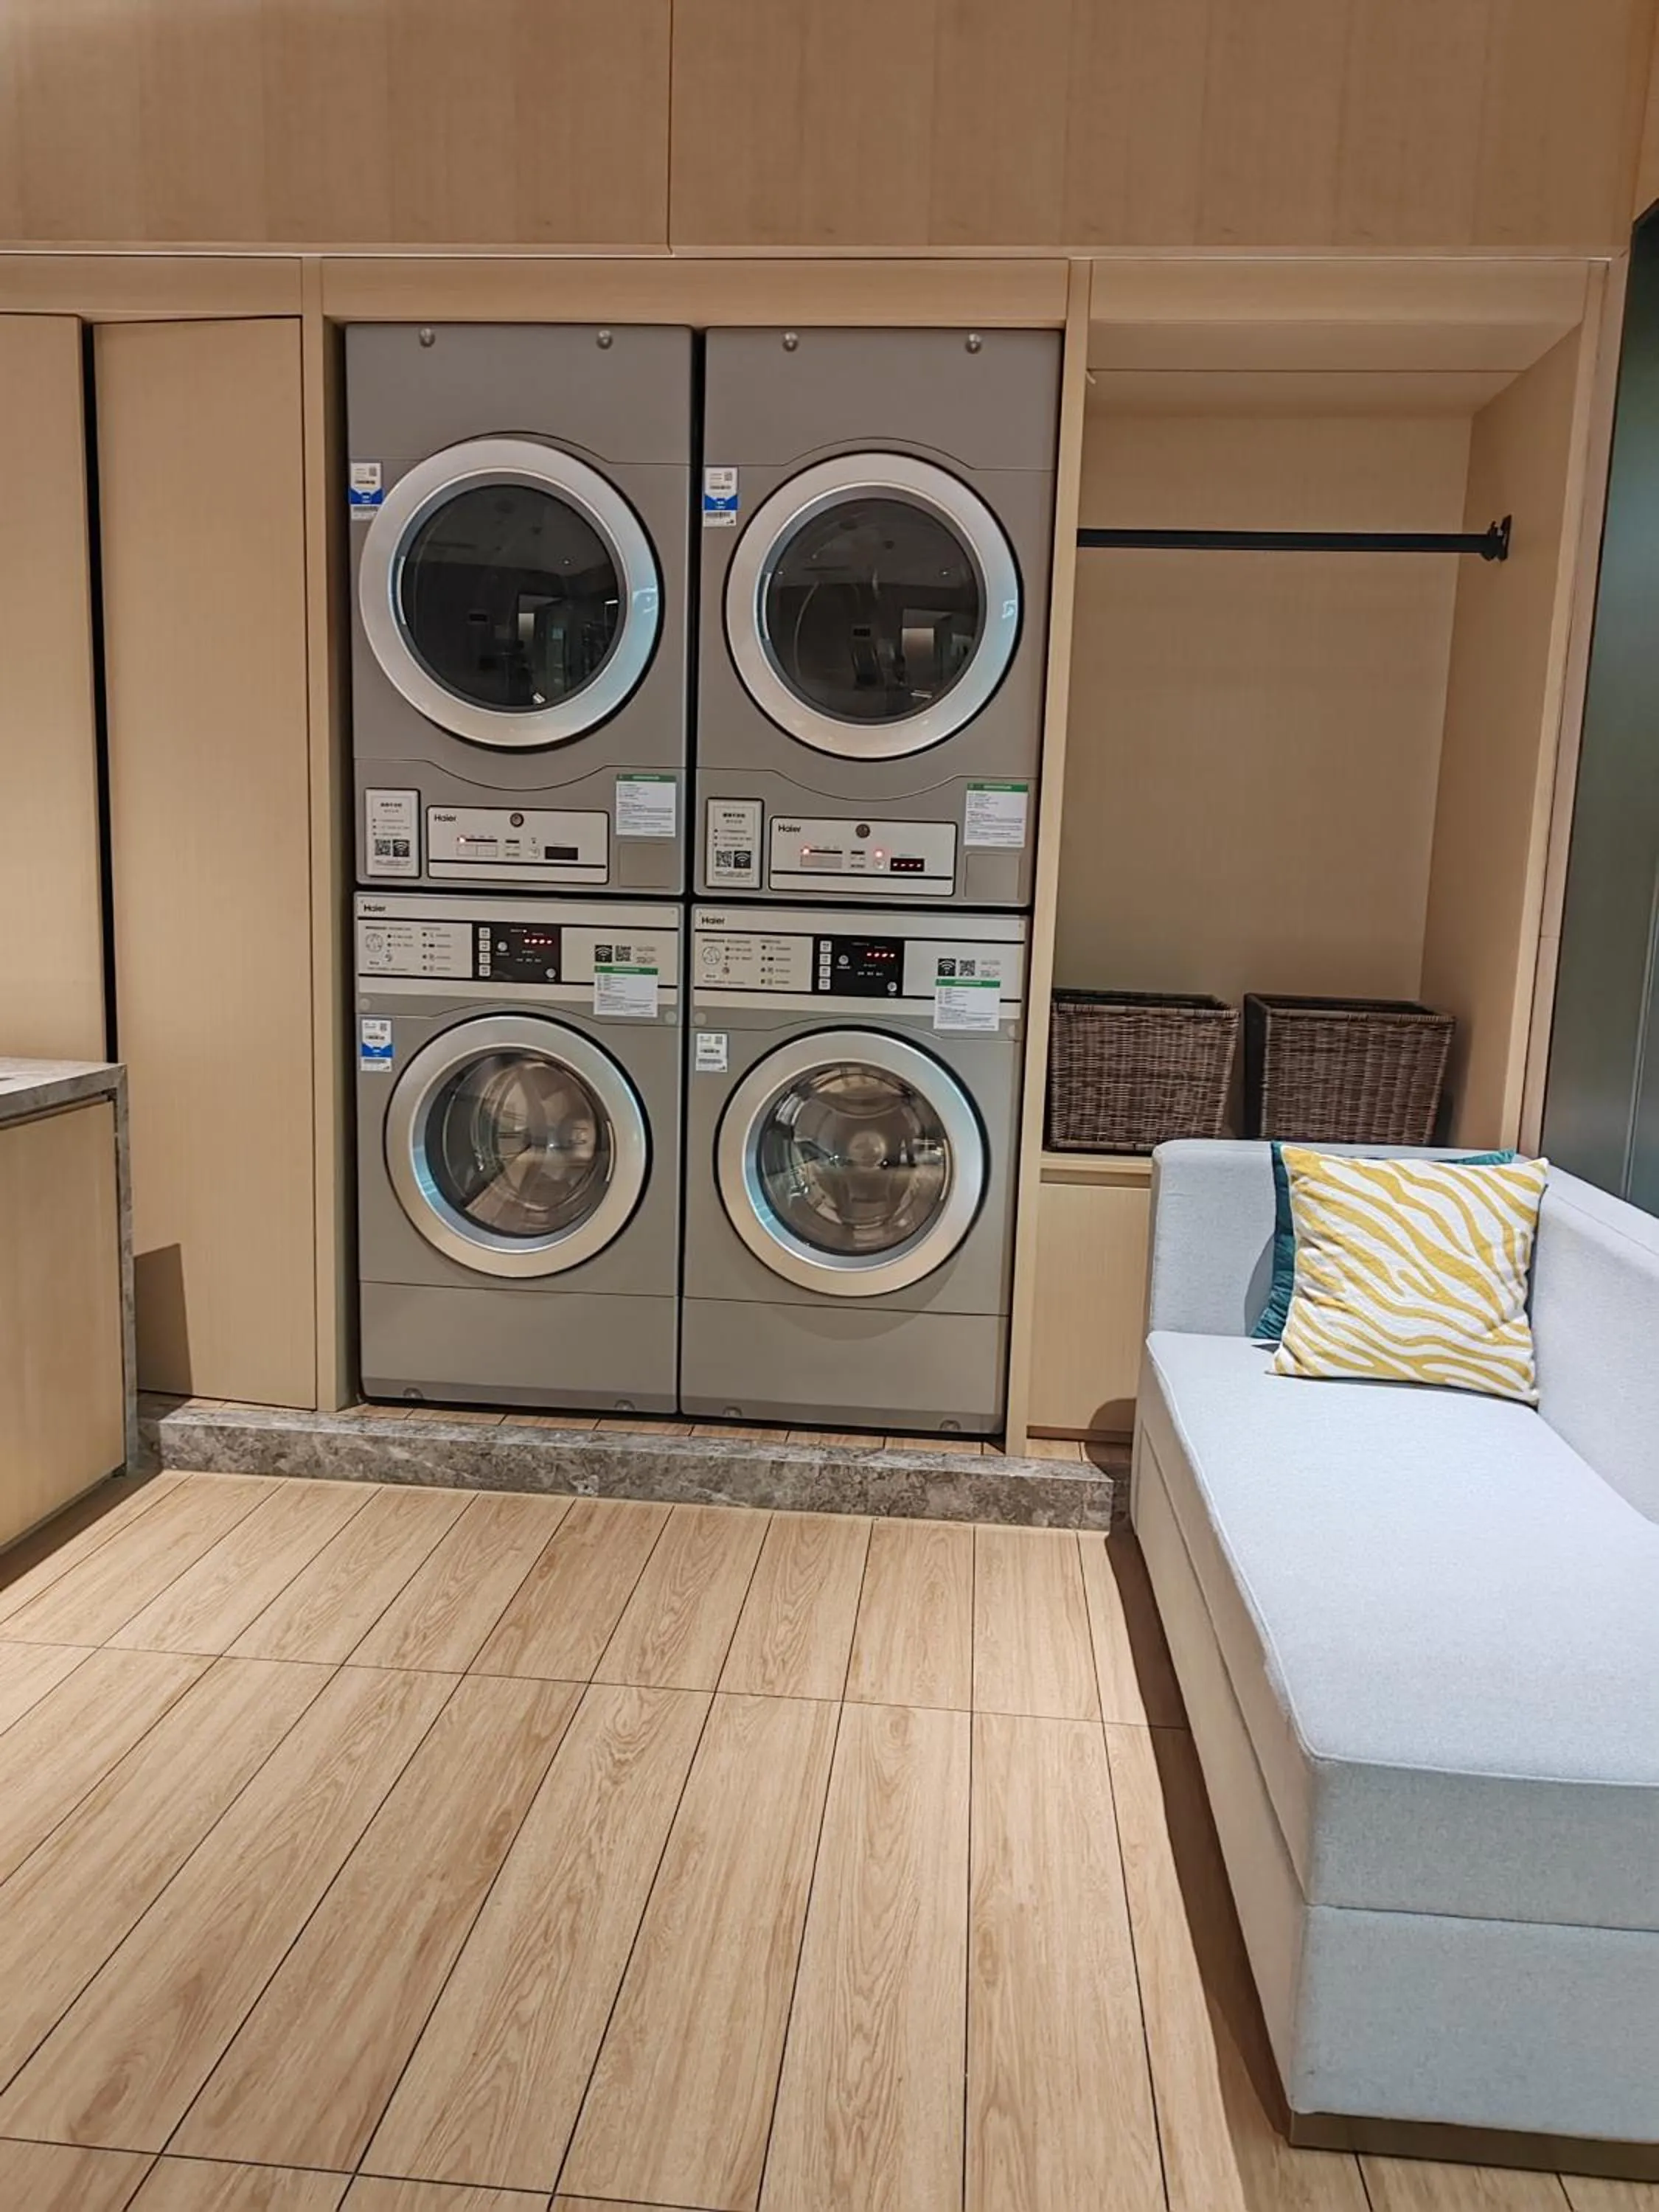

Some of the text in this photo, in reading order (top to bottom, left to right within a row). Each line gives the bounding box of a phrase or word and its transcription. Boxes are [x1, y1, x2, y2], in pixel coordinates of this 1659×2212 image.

[434, 814, 456, 822] Haier
[778, 824, 801, 832] Haier
[364, 904, 386, 912] Haier
[701, 917, 725, 925] Haier
